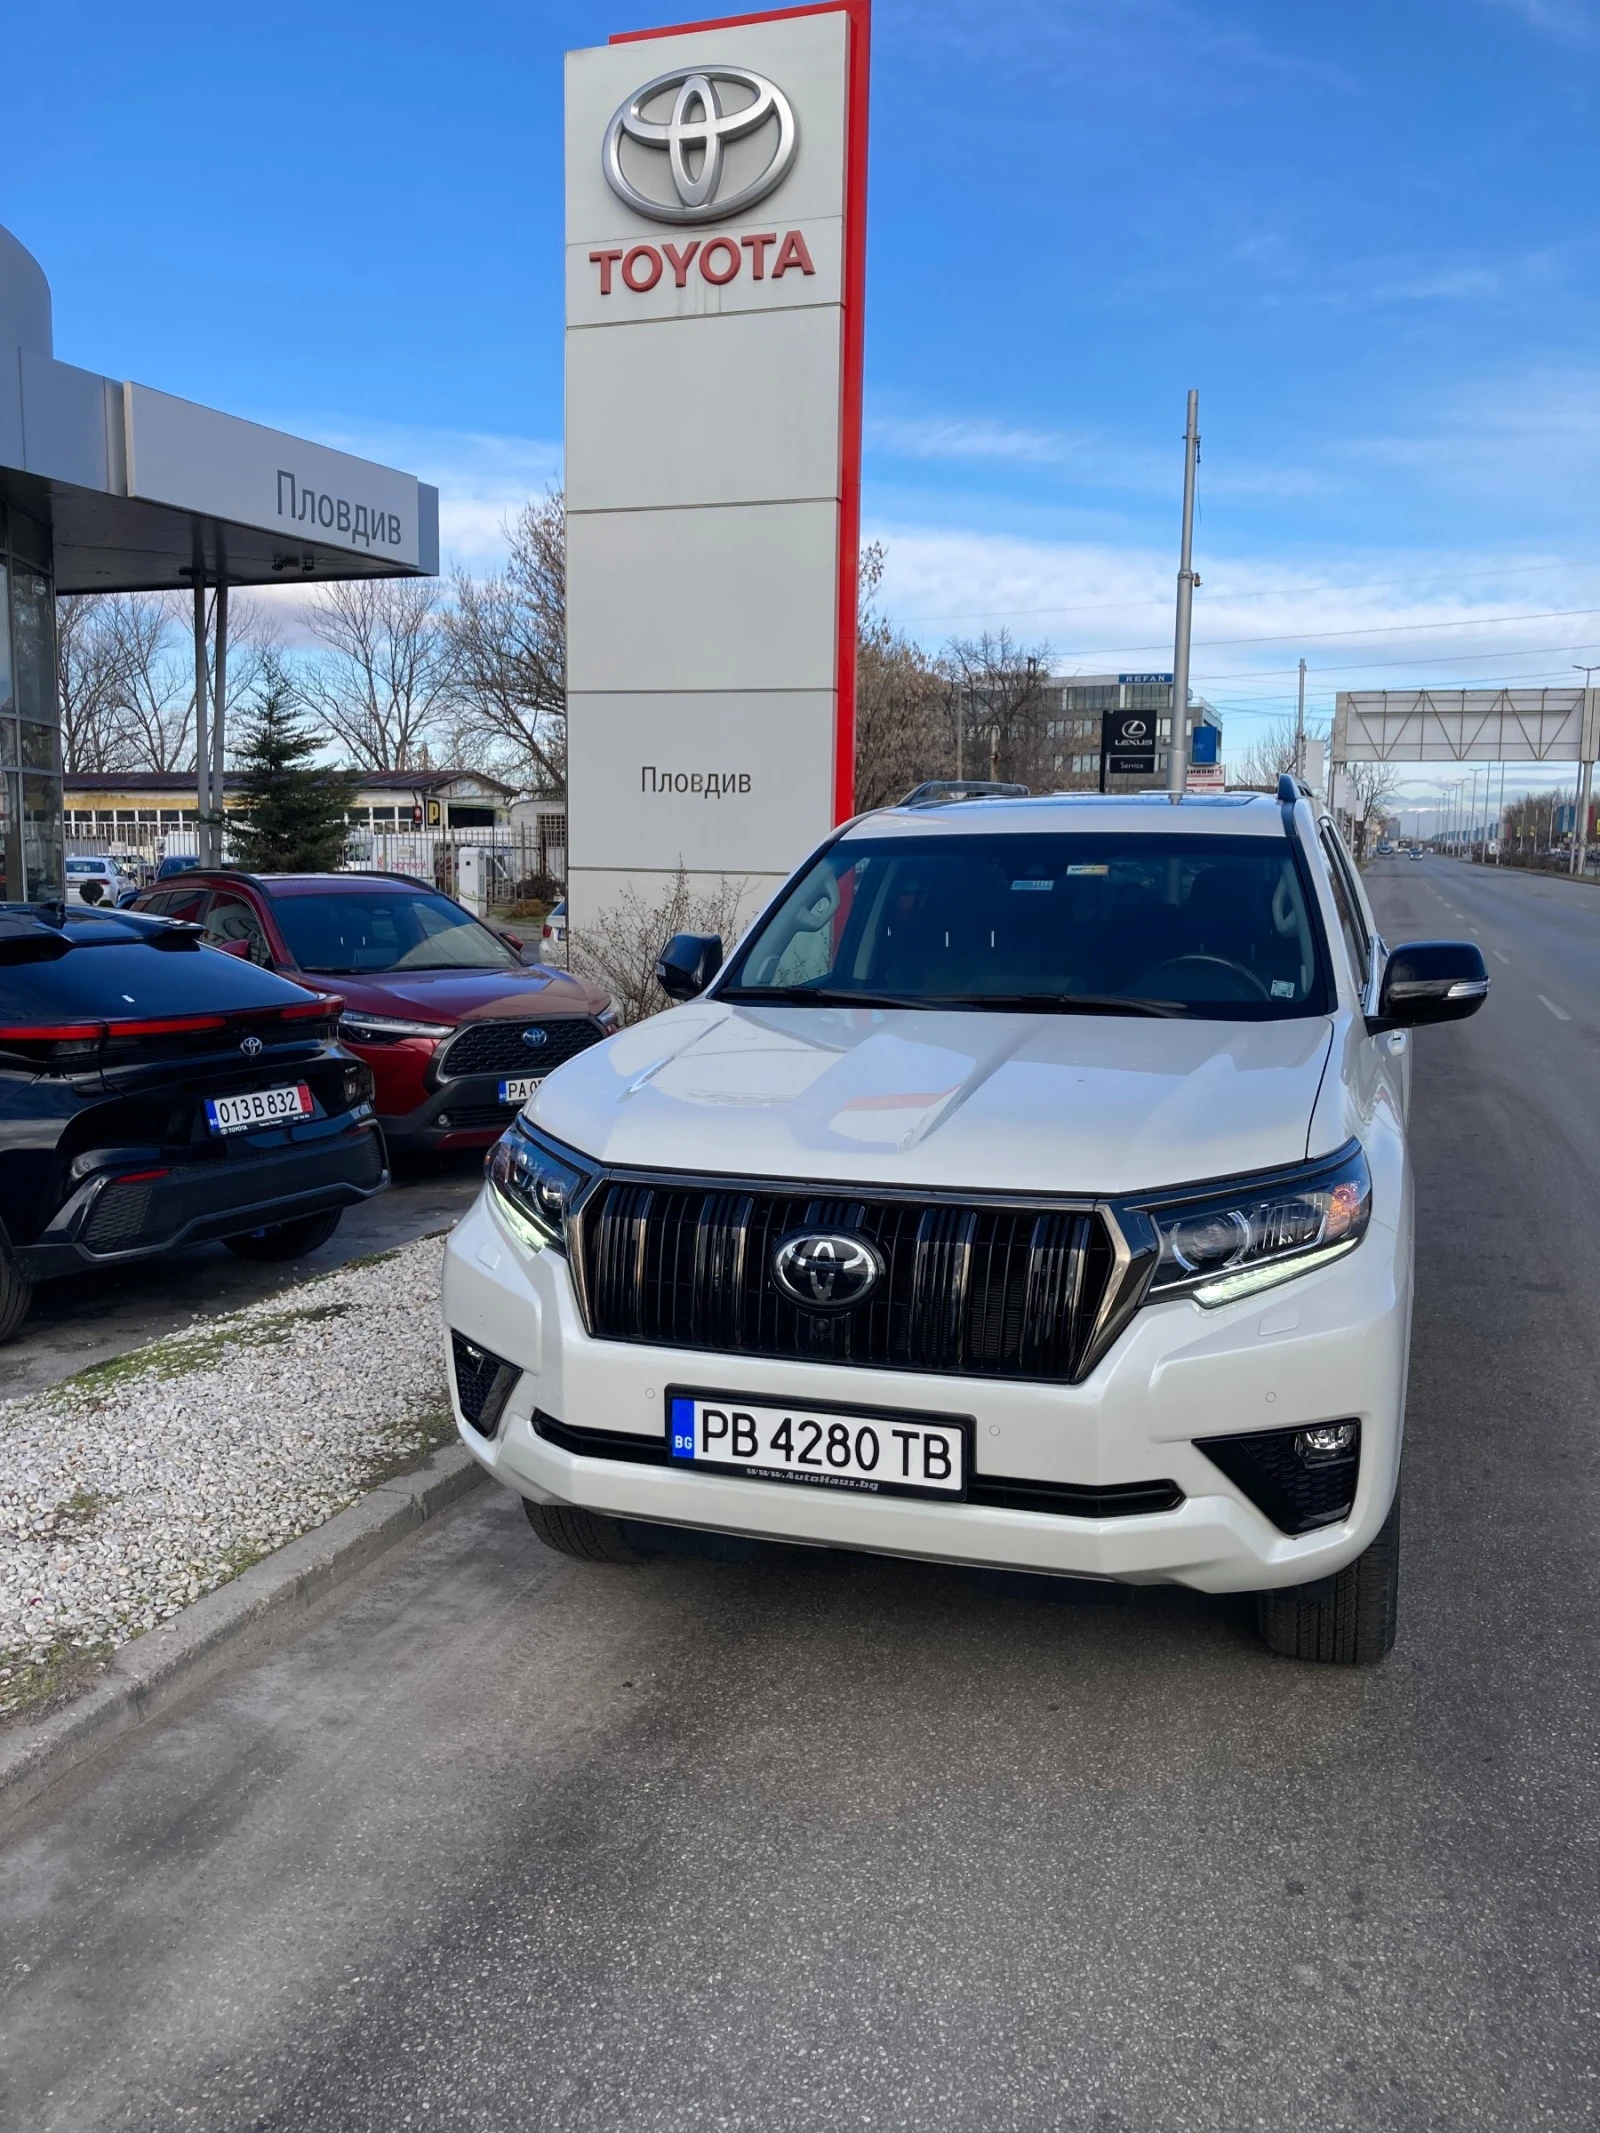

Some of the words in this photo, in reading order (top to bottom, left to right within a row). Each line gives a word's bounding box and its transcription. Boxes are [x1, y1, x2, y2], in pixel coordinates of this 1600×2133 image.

[588, 229, 816, 295] TOYOTA
[277, 469, 402, 547] Пловдив
[1120, 761, 1144, 769] Service
[642, 766, 752, 799] Пловдив
[228, 1124, 248, 1133] TOYOTA
[674, 1434, 693, 1450] BG
[702, 1408, 759, 1458] PB
[769, 1417, 880, 1471] 4280
[891, 1429, 952, 1480] TB
[746, 1467, 879, 1491] www.AutoHaus.bg
